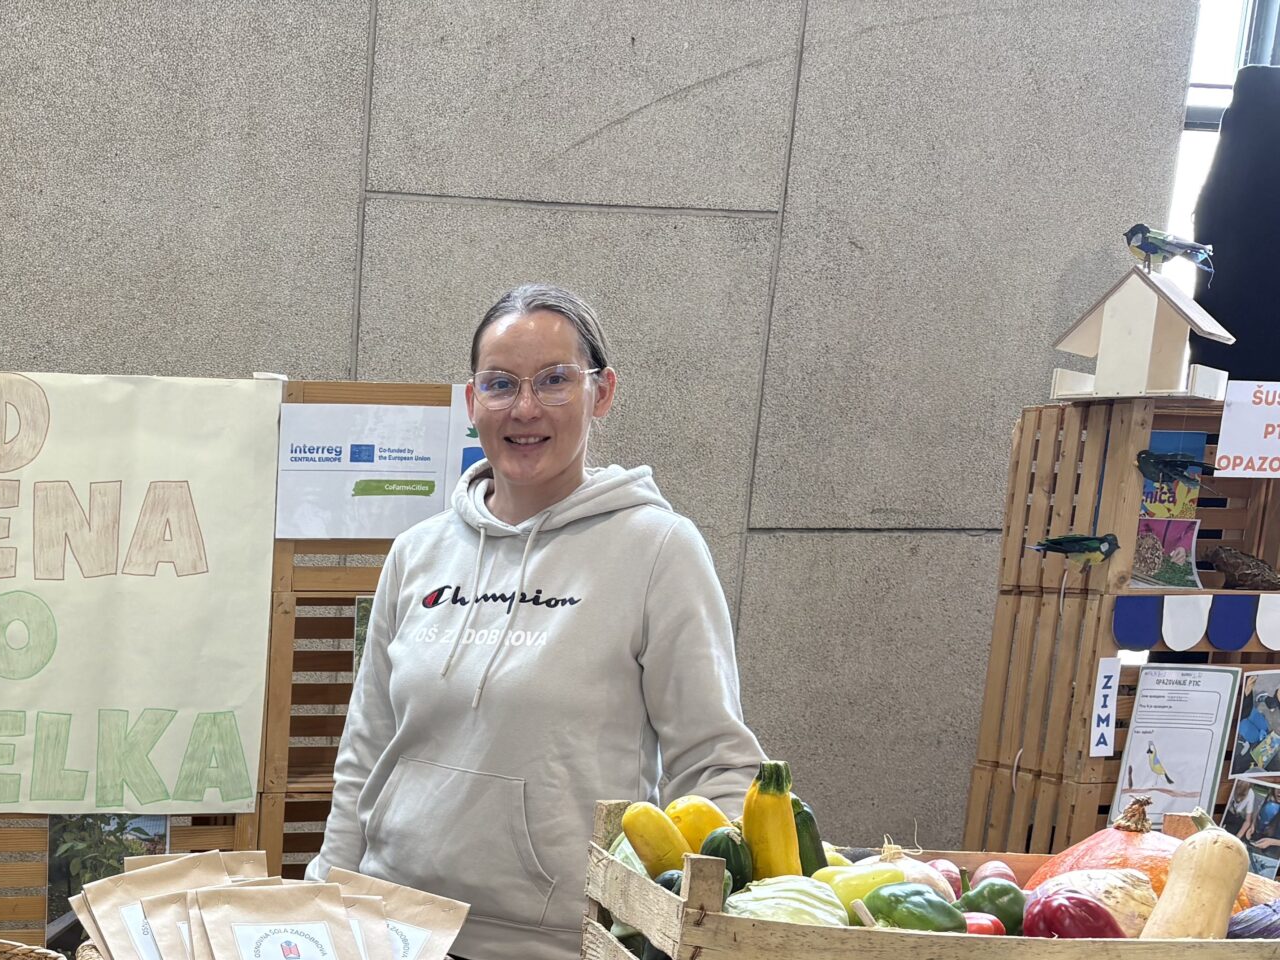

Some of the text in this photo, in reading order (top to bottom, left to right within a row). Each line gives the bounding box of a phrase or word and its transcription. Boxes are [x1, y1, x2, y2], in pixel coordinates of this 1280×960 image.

[290, 443, 343, 456] Interreg
[416, 624, 440, 643] OŠ
[1095, 674, 1114, 747] ZIMA
